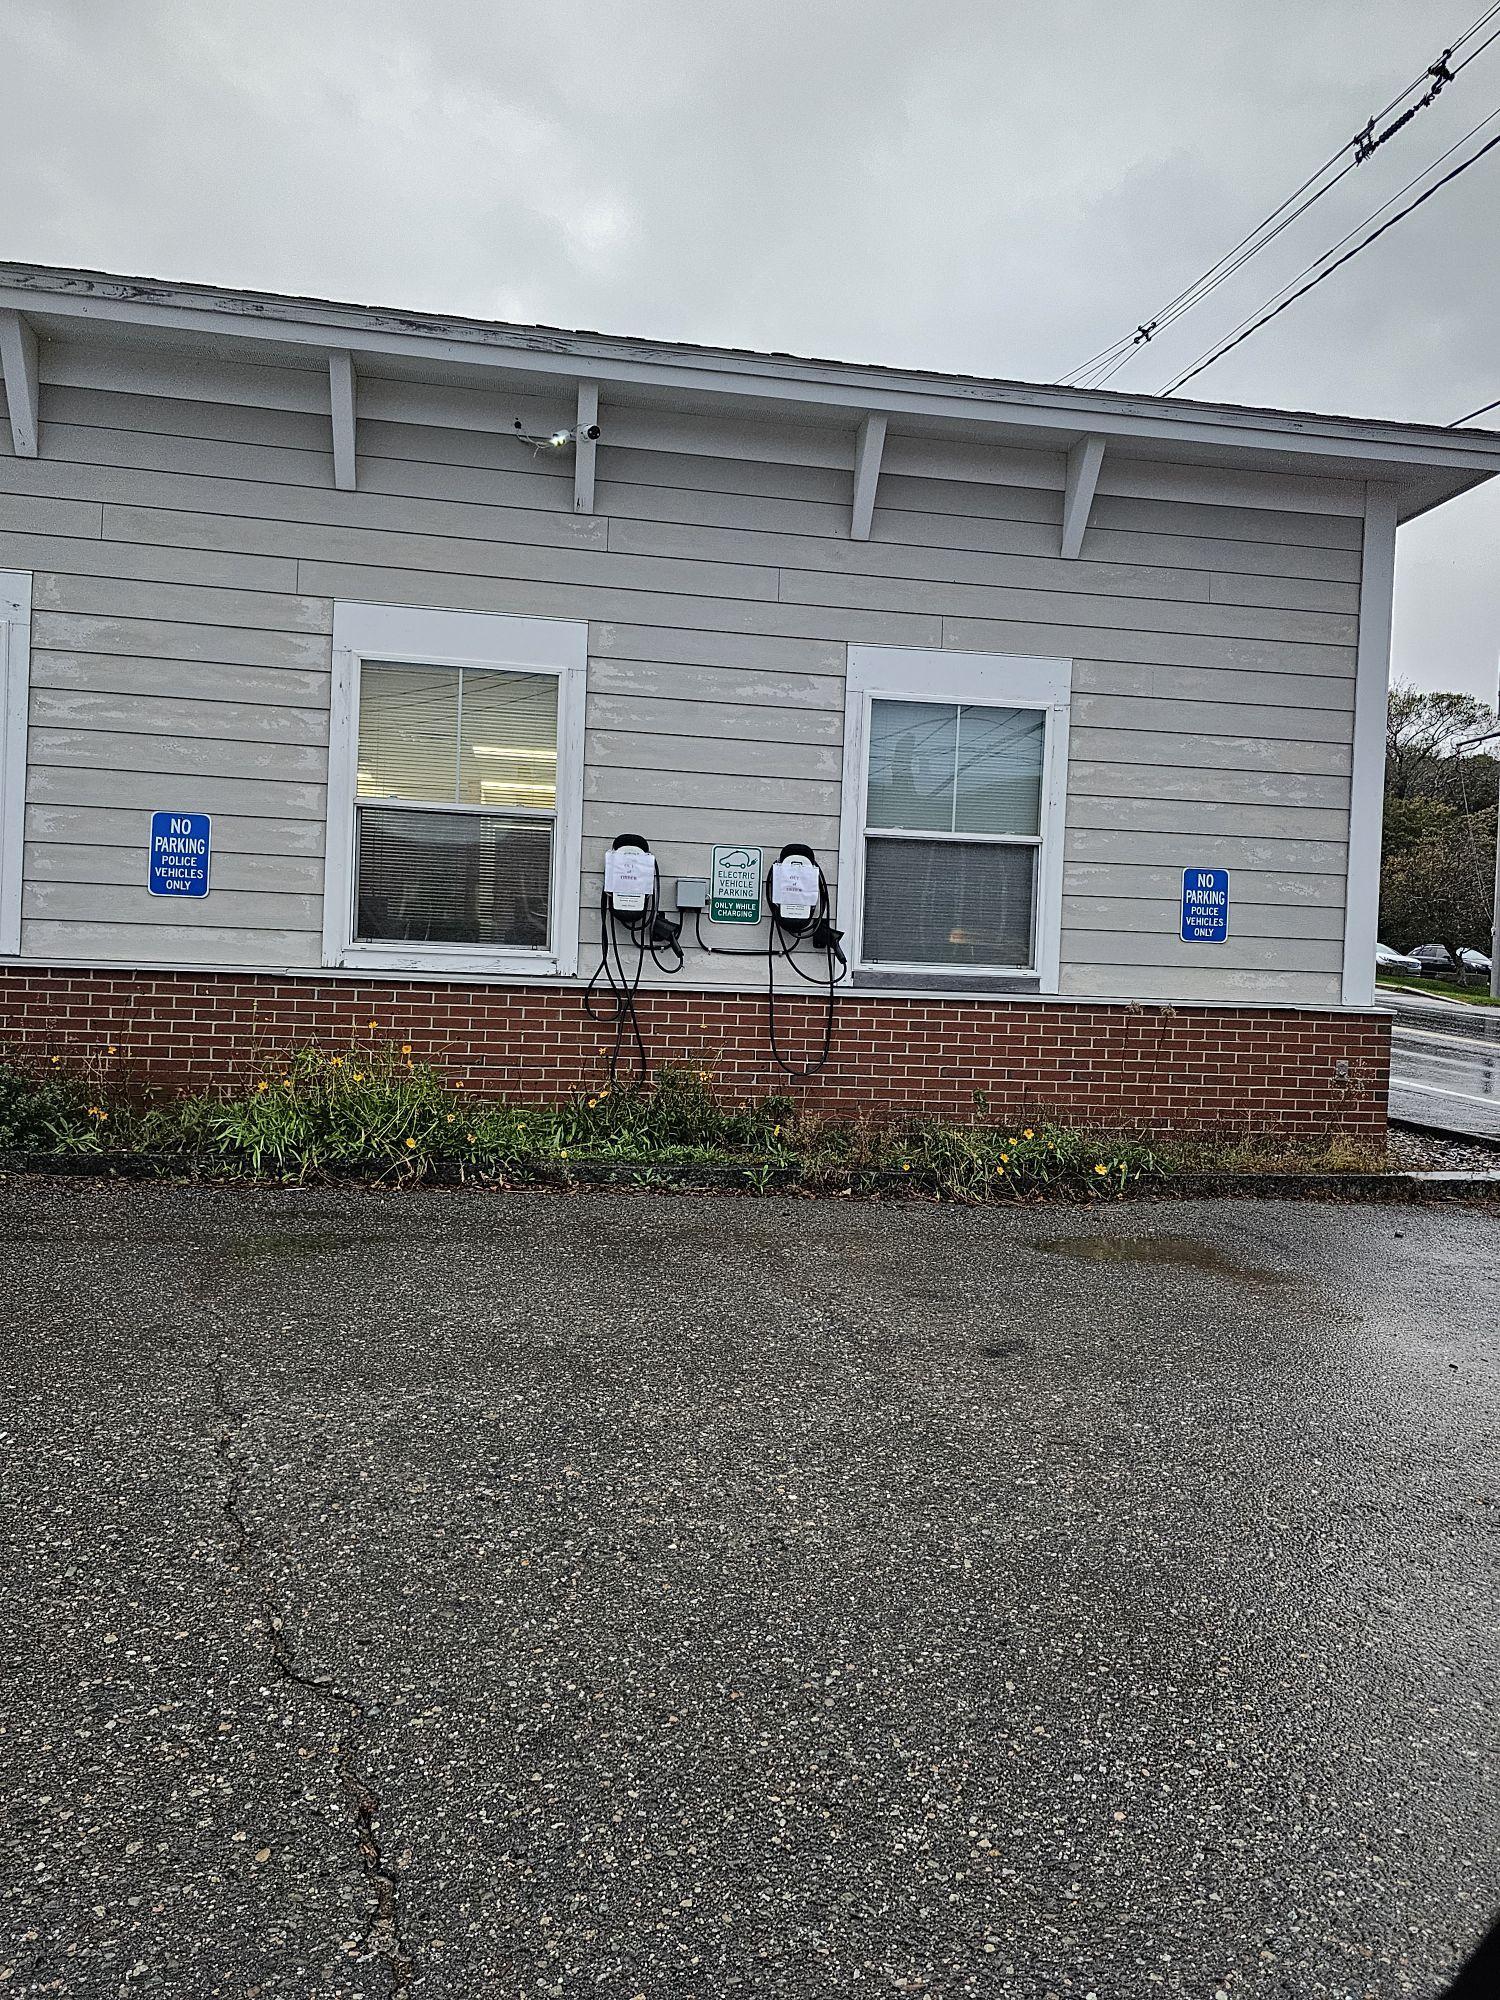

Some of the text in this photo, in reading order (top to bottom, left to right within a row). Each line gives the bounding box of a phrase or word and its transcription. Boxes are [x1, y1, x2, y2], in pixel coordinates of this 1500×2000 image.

[170, 818, 192, 834] NO
[155, 836, 205, 854] PARKING
[162, 856, 197, 866] POLICE
[155, 867, 204, 878] VEHICLES
[718, 870, 755, 880] ELECTRIC
[166, 880, 191, 890] ONLY
[720, 880, 753, 888] VEHICLE
[1198, 874, 1214, 888] NO
[718, 888, 754, 897] PARKING
[1186, 890, 1225, 905] PARKING
[1192, 906, 1218, 916] POLICE
[1186, 917, 1224, 926] VEHICLES
[1194, 928, 1214, 936] ONLY
